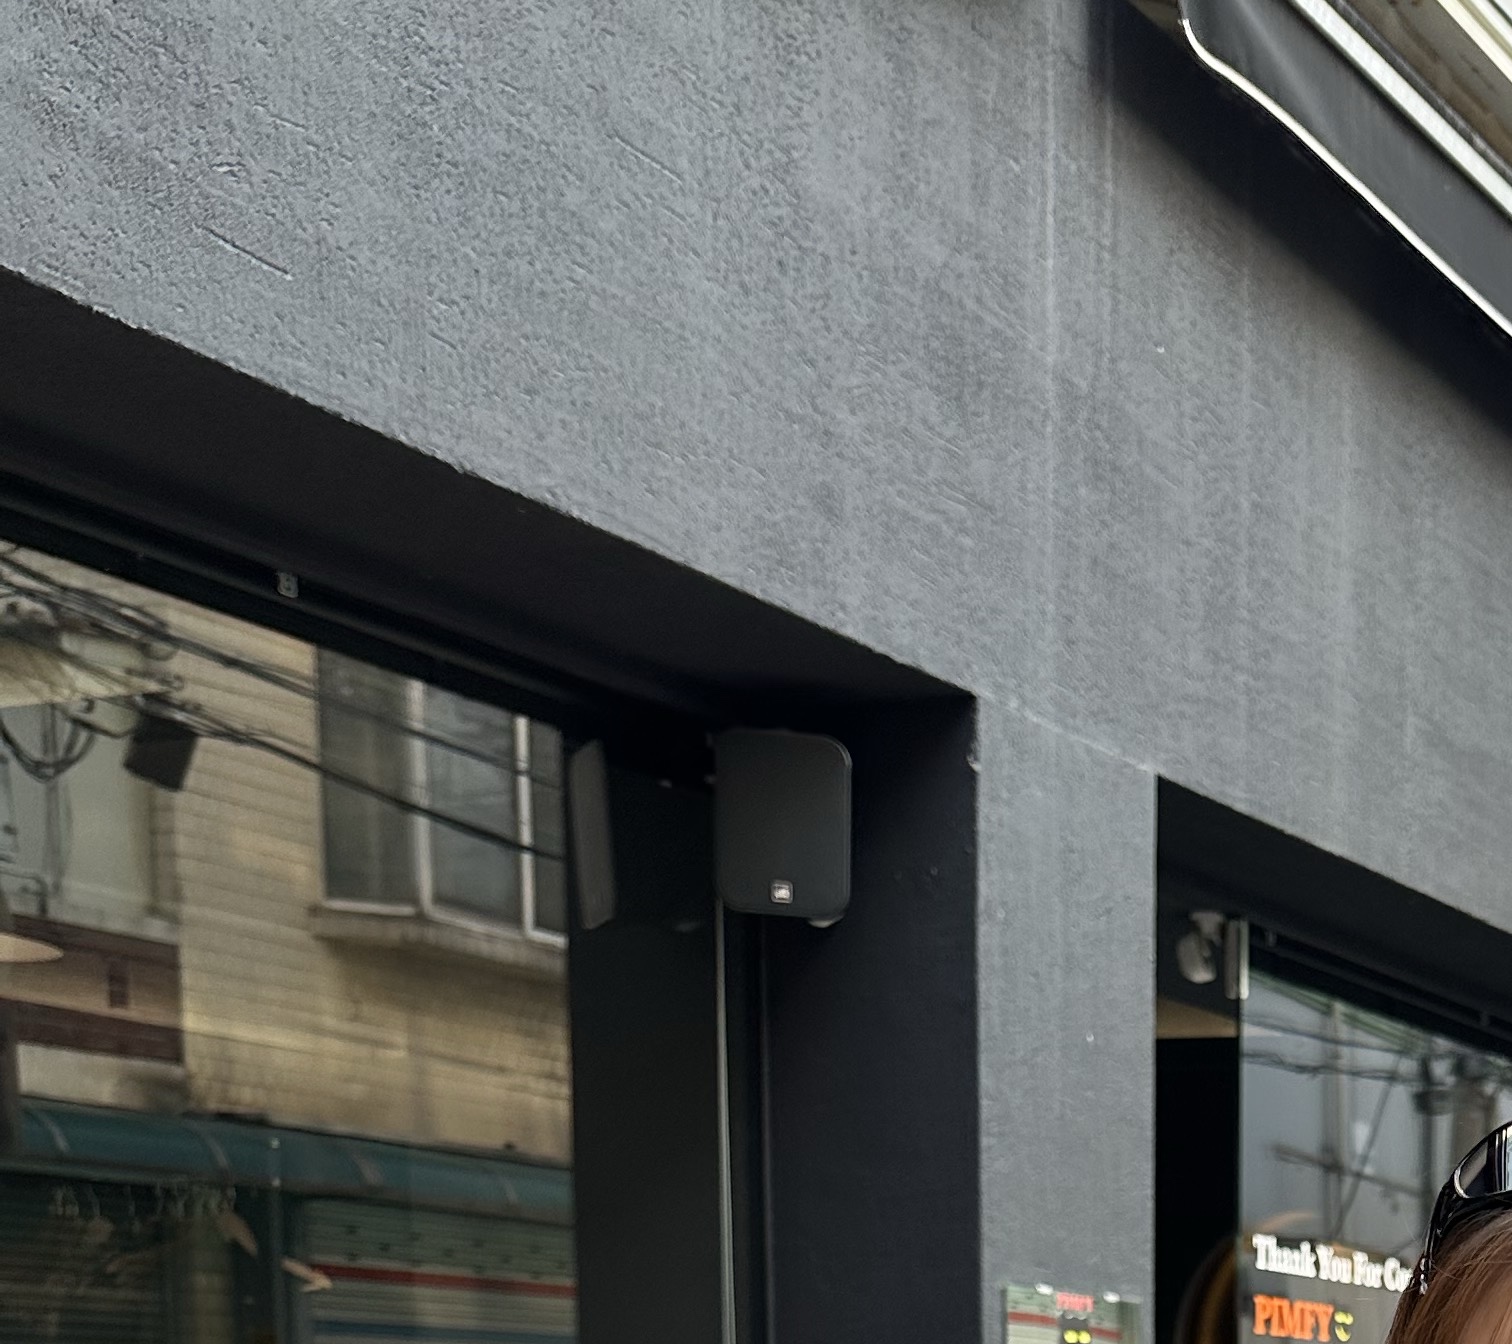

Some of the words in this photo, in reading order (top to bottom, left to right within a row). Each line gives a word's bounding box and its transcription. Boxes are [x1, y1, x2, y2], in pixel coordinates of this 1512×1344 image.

[1252, 1233, 1317, 1279] Thank
[1316, 1243, 1352, 1284] You
[1352, 1251, 1383, 1288] For
[1253, 1293, 1334, 1343] PIMFY
